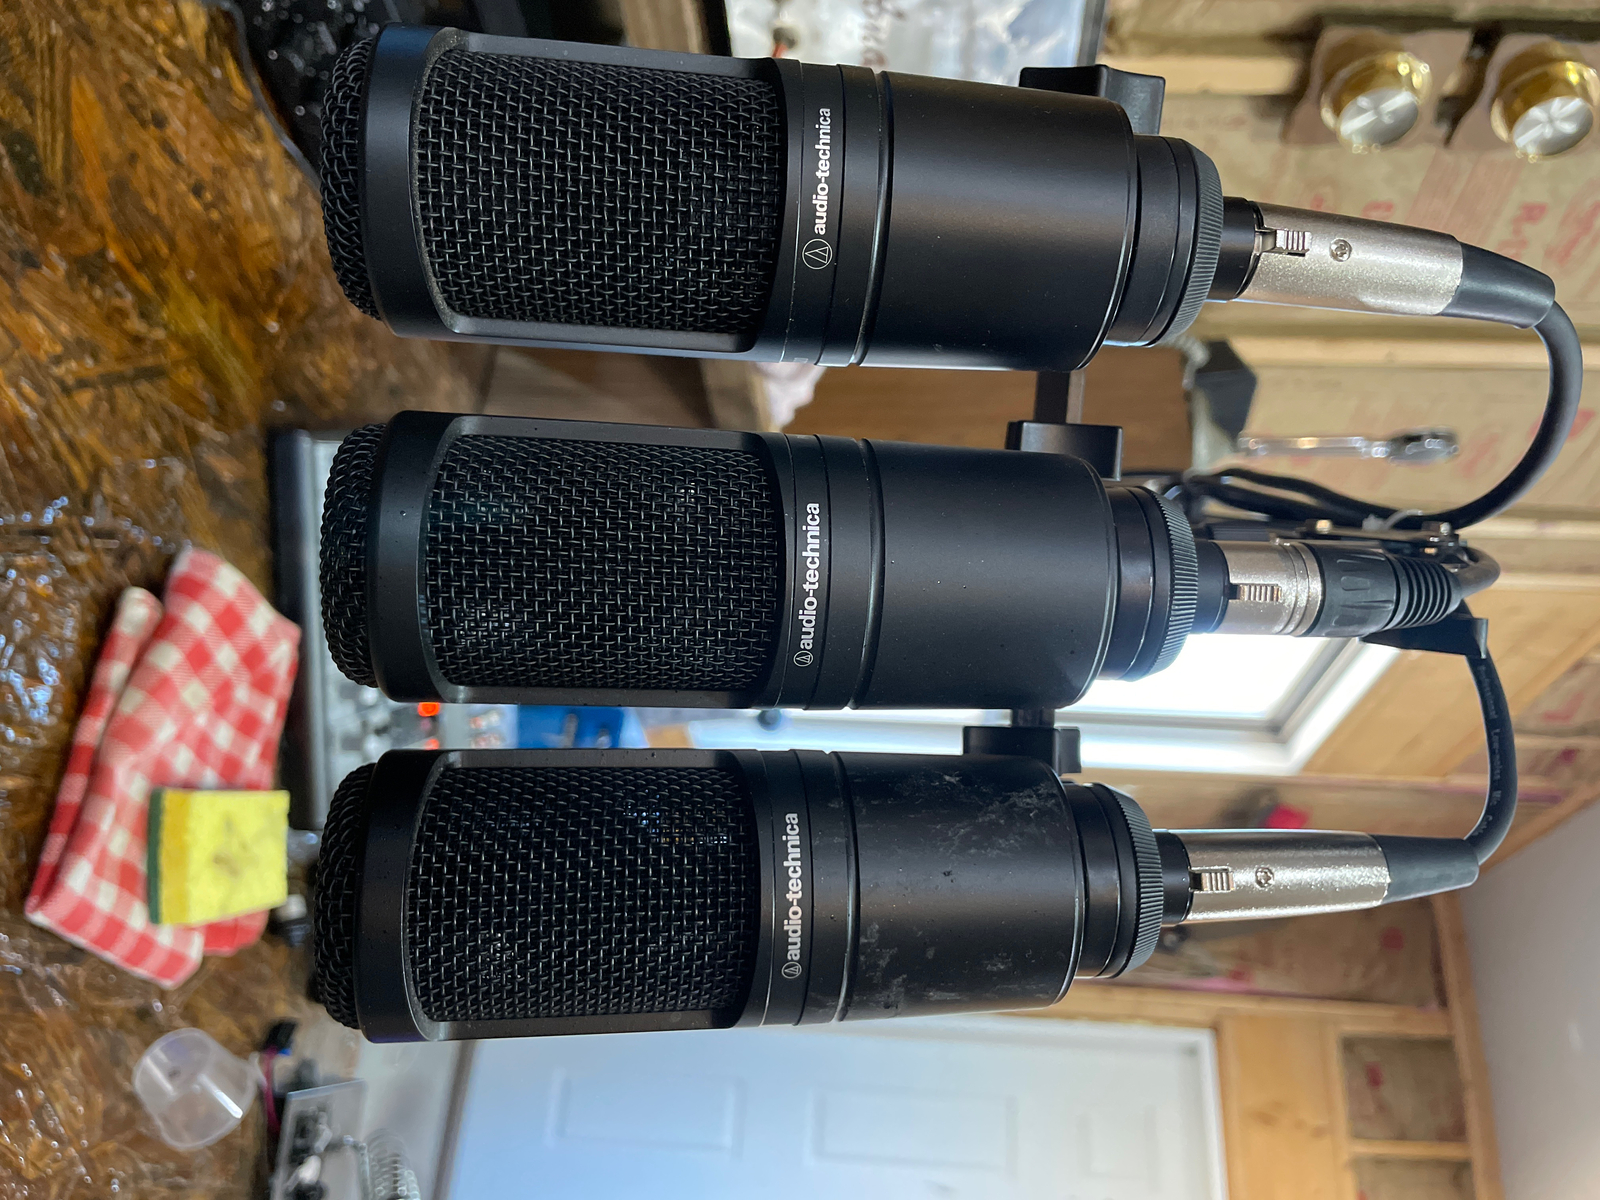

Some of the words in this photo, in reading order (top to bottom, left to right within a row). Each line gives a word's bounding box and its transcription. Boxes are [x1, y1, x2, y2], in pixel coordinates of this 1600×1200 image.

[812, 107, 831, 235] audio-technica
[798, 502, 820, 650] audio-technica
[783, 812, 803, 961] audio-technica
